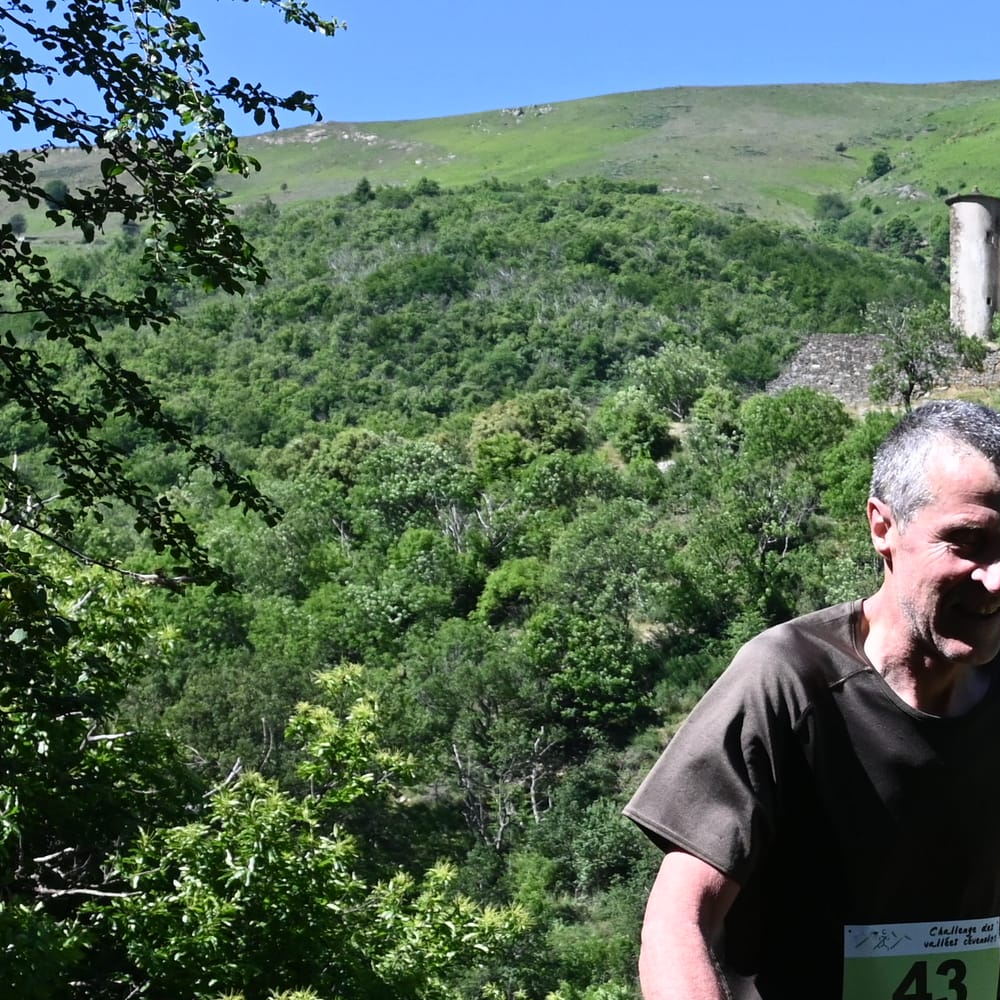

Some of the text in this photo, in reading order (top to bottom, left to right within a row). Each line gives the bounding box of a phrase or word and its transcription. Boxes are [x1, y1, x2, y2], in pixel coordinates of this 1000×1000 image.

[929, 922, 994, 938] Challenge des
[924, 937, 958, 948] vallées
